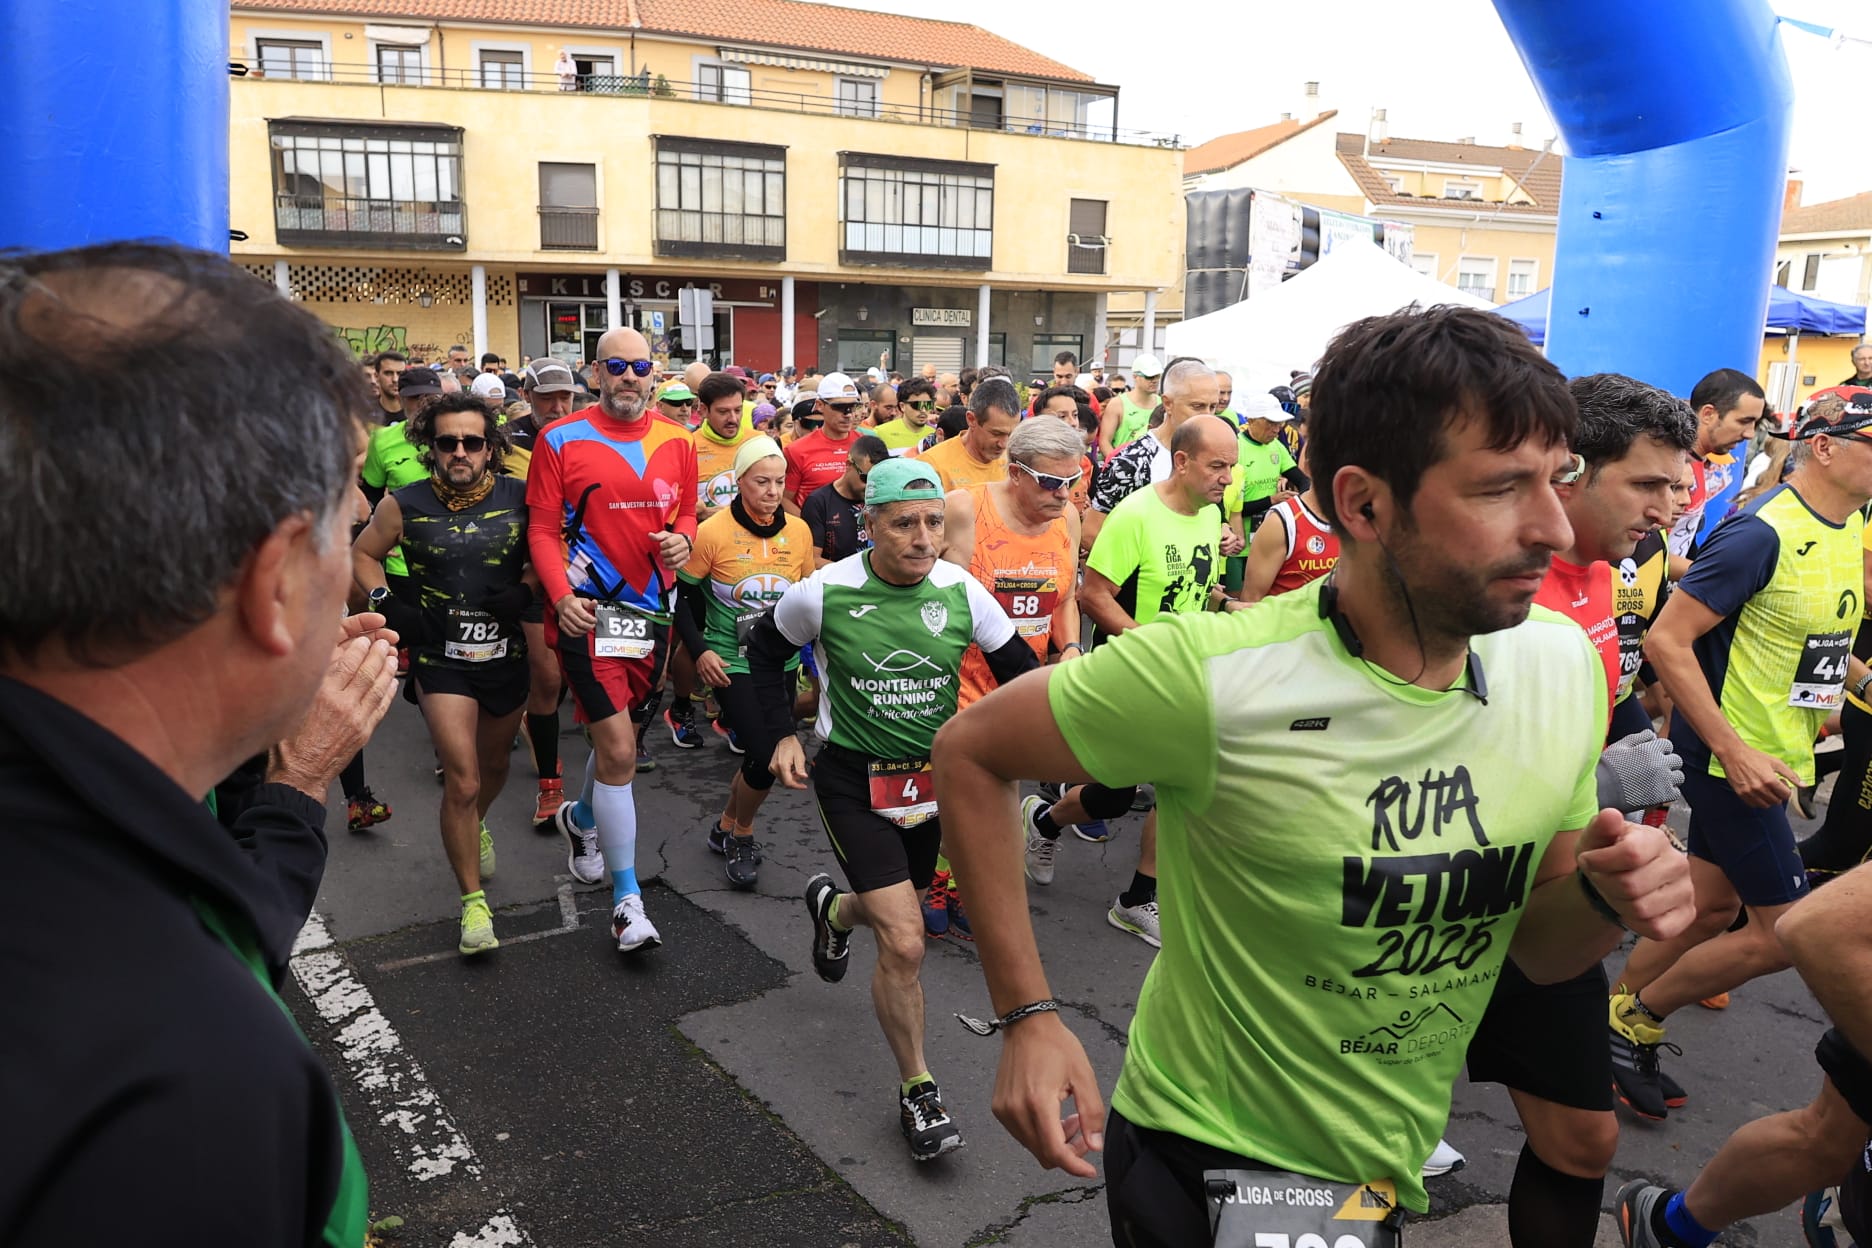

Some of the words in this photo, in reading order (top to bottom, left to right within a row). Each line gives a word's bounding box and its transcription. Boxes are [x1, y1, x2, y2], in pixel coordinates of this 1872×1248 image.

[914, 309, 941, 322] CLINICA
[944, 310, 970, 323] DENTAL
[620, 501, 646, 509] SILVESTRE
[1166, 554, 1182, 563] LIGA
[1167, 562, 1186, 570] CROSS
[1298, 557, 1339, 571] VILLO
[1003, 581, 1016, 589] LIGA
[1020, 581, 1038, 589] CROSS
[1012, 595, 1040, 615] 58
[1617, 600, 1643, 611] CROSS
[459, 621, 500, 641] 782
[608, 617, 647, 637] 523
[1817, 639, 1834, 647] LIGA
[850, 674, 952, 692] MONTEMURO
[873, 690, 936, 705] RUNNING
[1294, 719, 1327, 728] 42K
[871, 763, 880, 771] 33
[880, 763, 897, 771] LGA
[902, 778, 919, 802] 4
[1364, 764, 1491, 852] RUTA
[1341, 841, 1536, 928] VETONA
[1351, 917, 1502, 979] 2025
[1304, 974, 1378, 1001] BÉJAR
[1340, 1035, 1399, 1055] BÉJAR
[1236, 1186, 1273, 1206] LIGA
[1274, 1190, 1285, 1201] DE
[1286, 1187, 1334, 1207] CROSS
